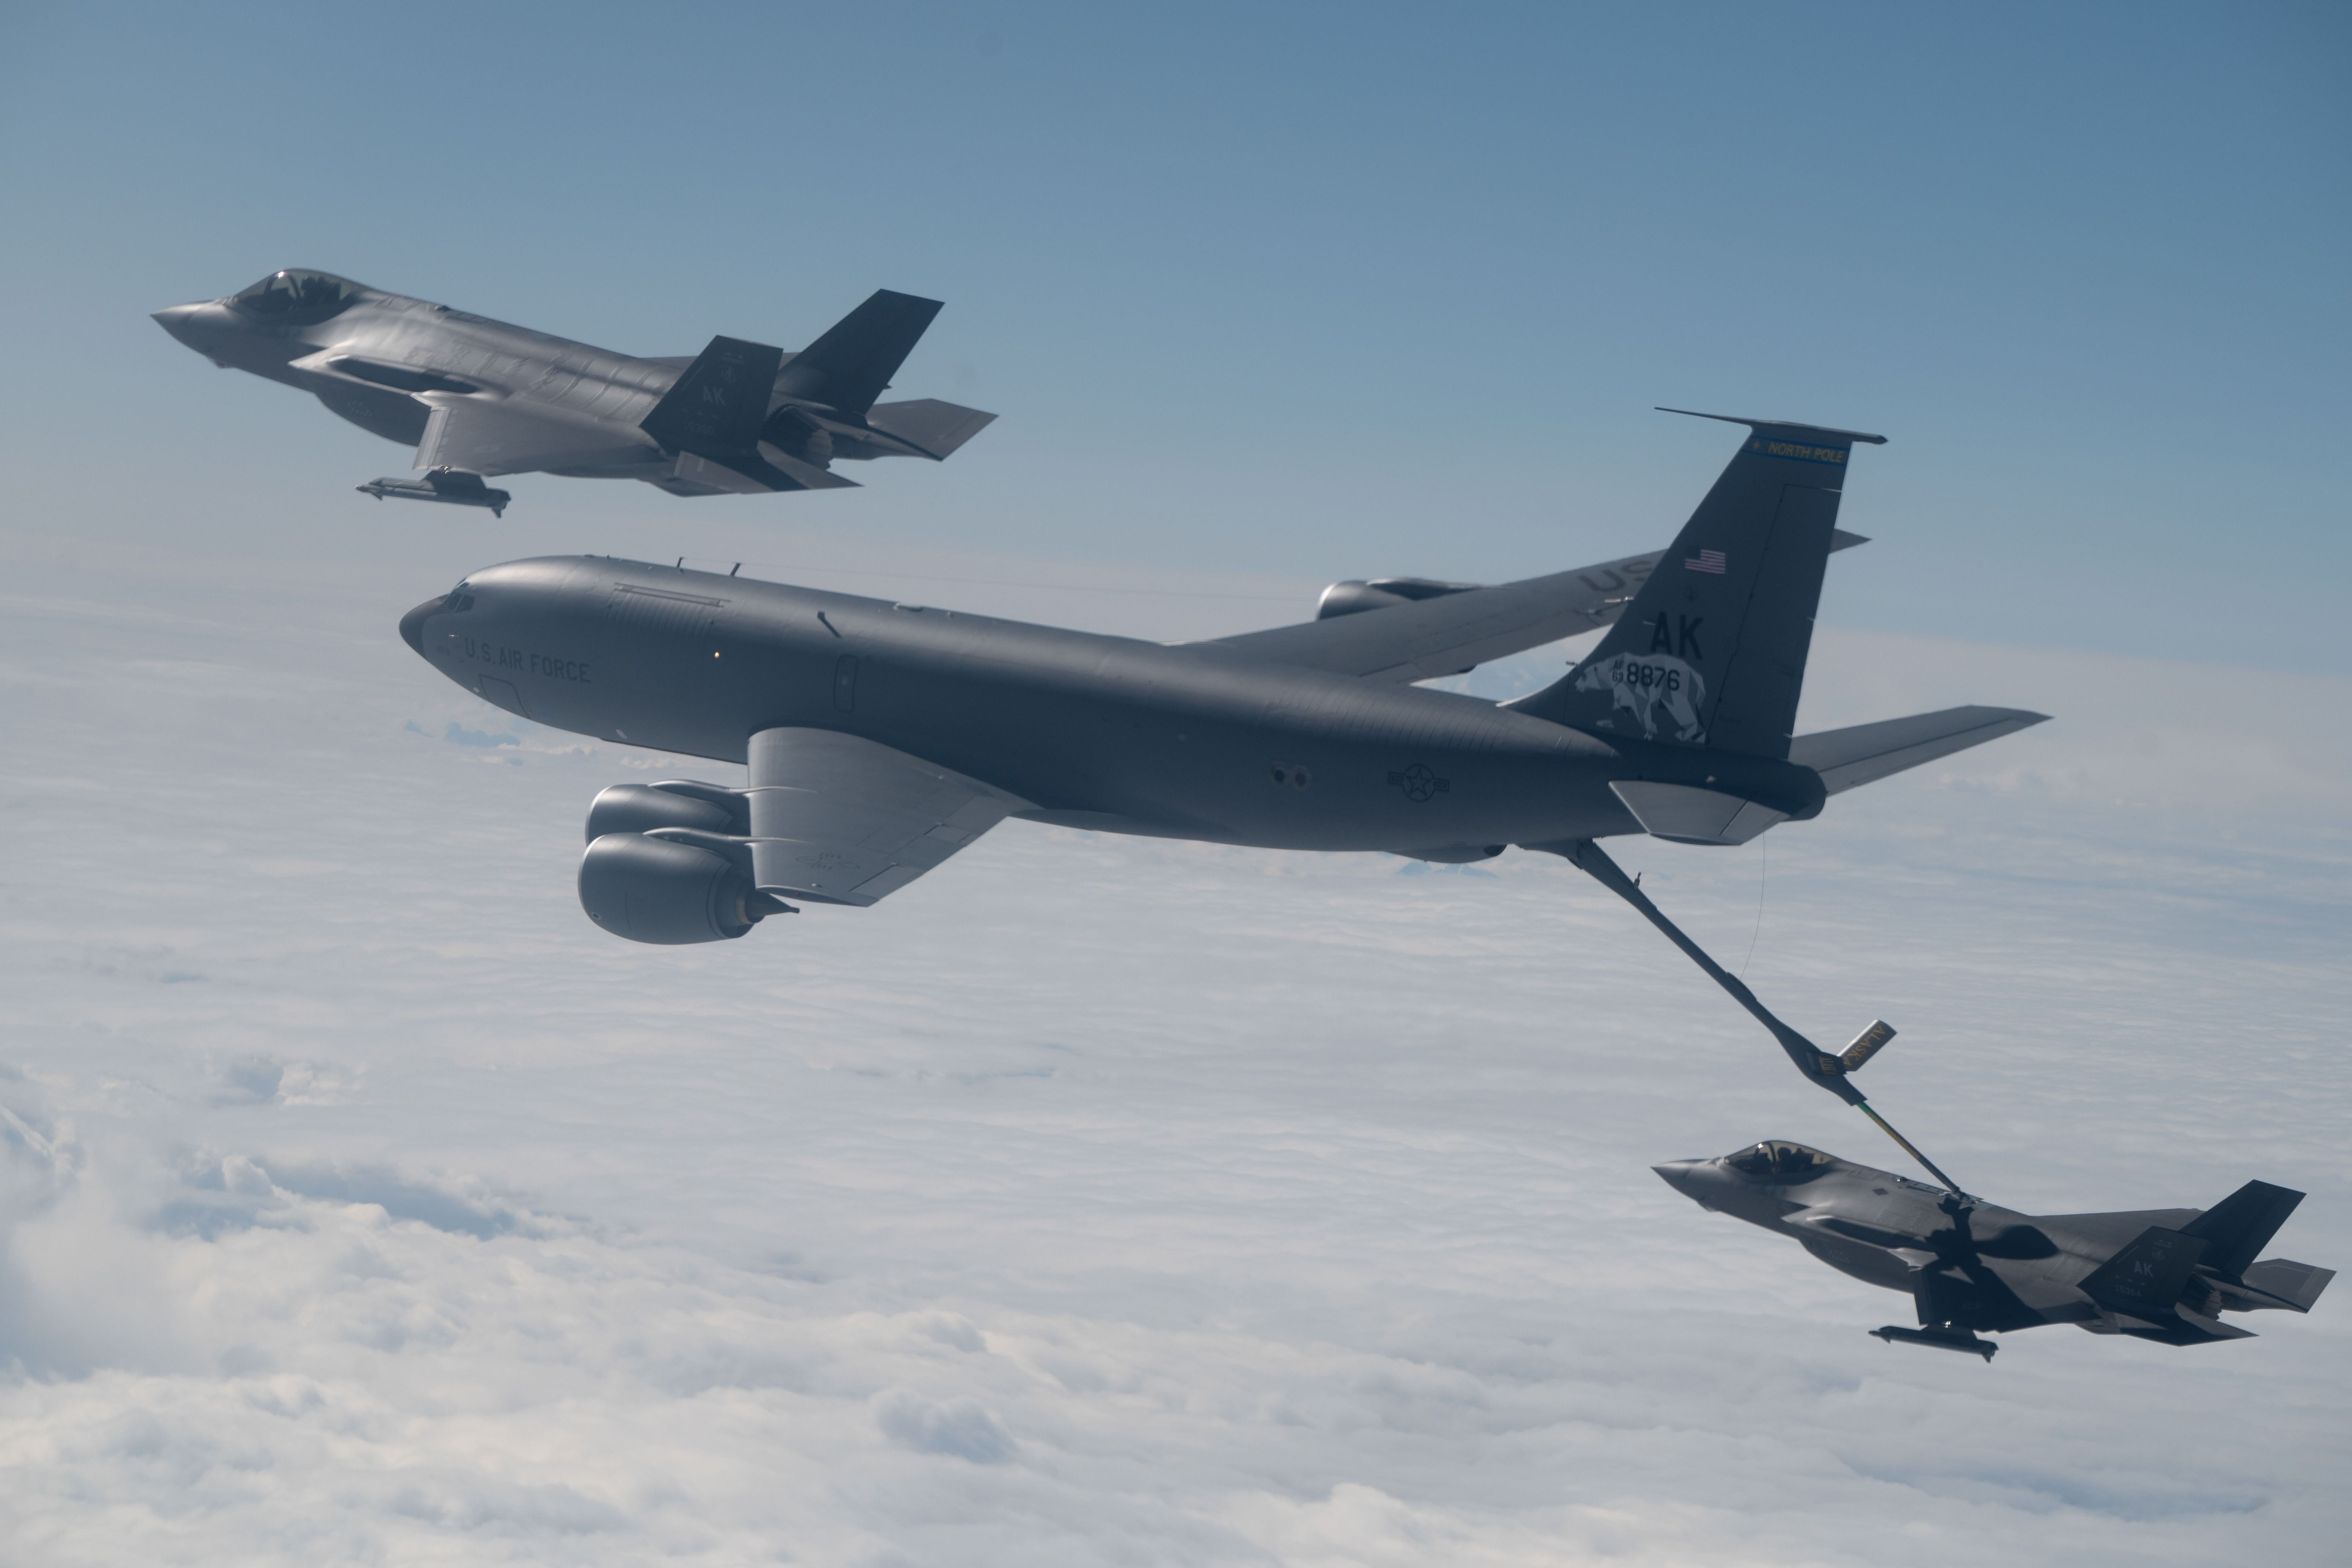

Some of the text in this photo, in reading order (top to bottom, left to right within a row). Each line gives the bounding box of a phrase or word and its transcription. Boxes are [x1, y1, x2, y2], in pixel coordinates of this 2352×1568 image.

[703, 385, 727, 407] AK
[1768, 441, 1844, 463] NORTH POLE
[1651, 611, 1704, 661] AK
[465, 637, 496, 664] U.S.
[499, 646, 524, 671] AIR
[530, 653, 592, 683] FORCE
[1626, 662, 1680, 691] 8876
[1843, 1026, 1886, 1065] ALASKA
[2133, 1260, 2155, 1278] AK
